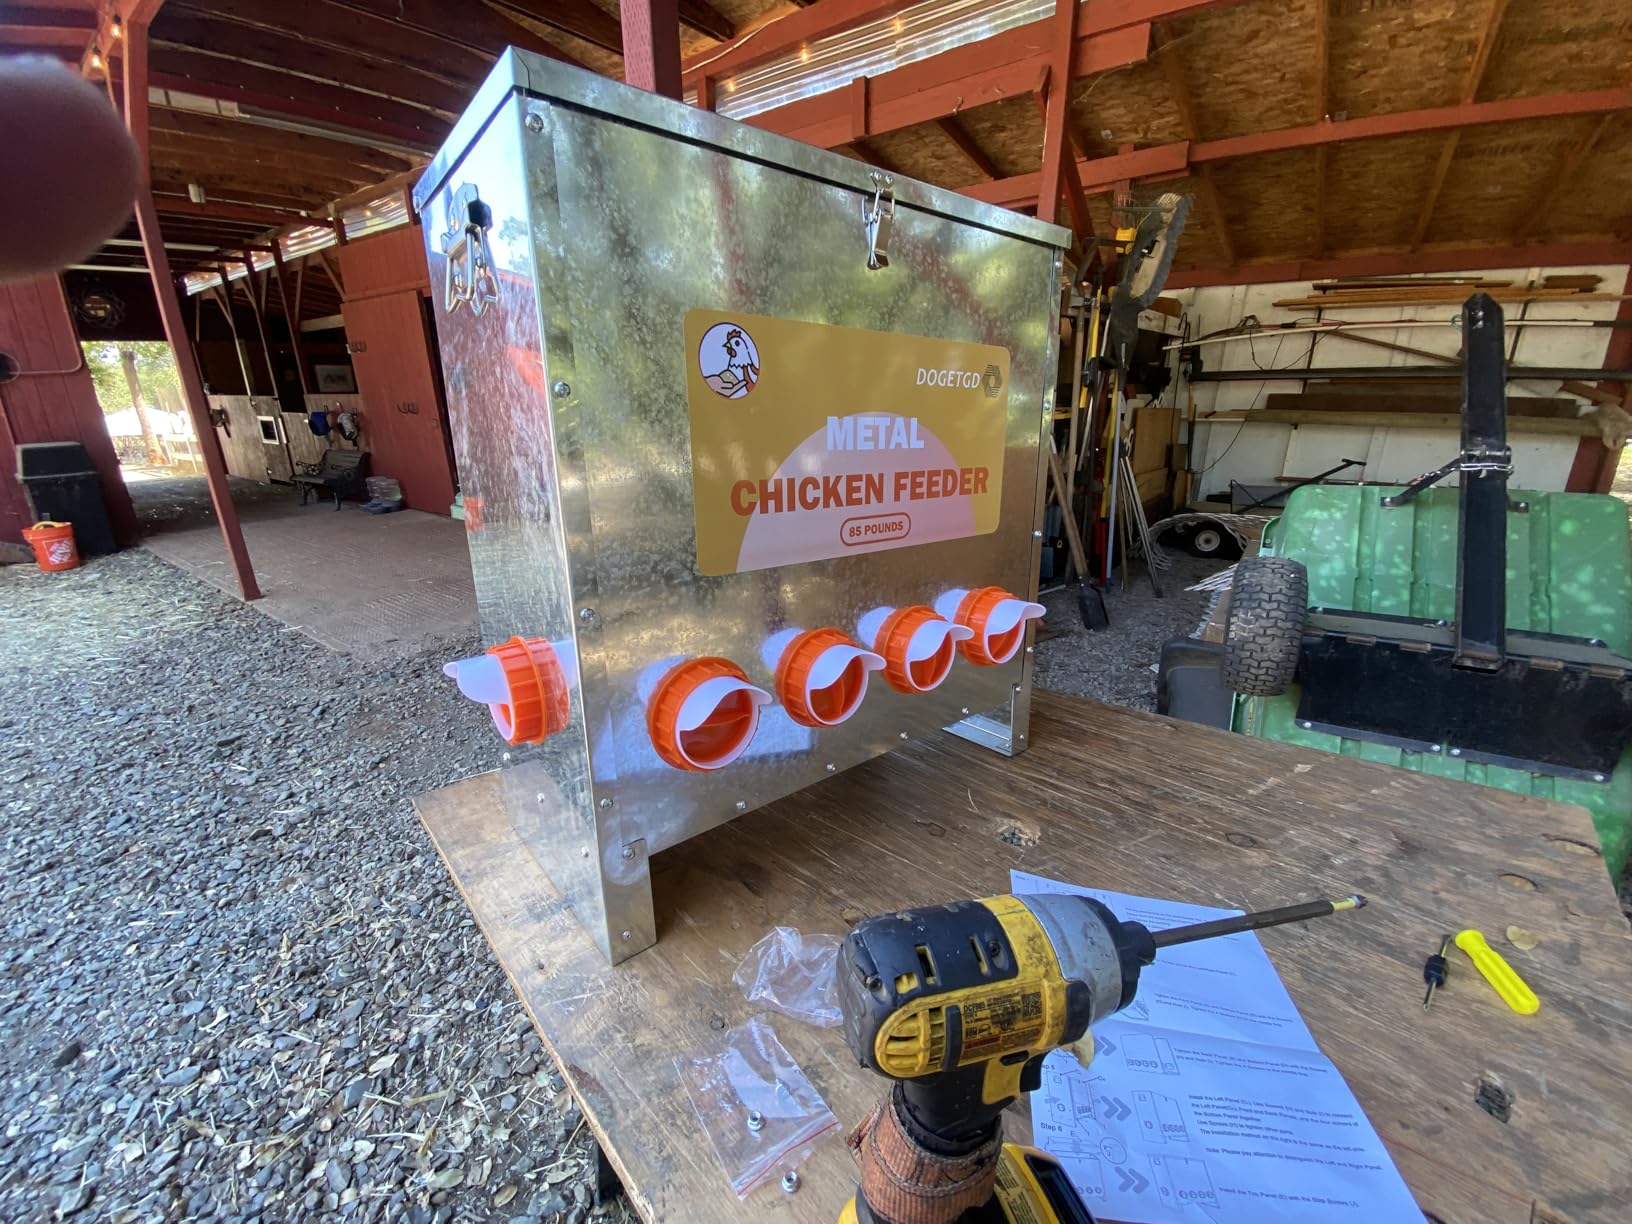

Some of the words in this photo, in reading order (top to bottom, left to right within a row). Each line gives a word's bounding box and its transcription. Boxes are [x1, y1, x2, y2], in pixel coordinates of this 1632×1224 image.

[916, 367, 981, 389] DOGETGD
[827, 415, 924, 450] METAL
[730, 472, 885, 516] CHICKEN
[893, 466, 989, 502] FEEDER
[849, 526, 863, 538] 85
[864, 521, 904, 536] POUNDS
[1040, 1122, 1056, 1132] Step
